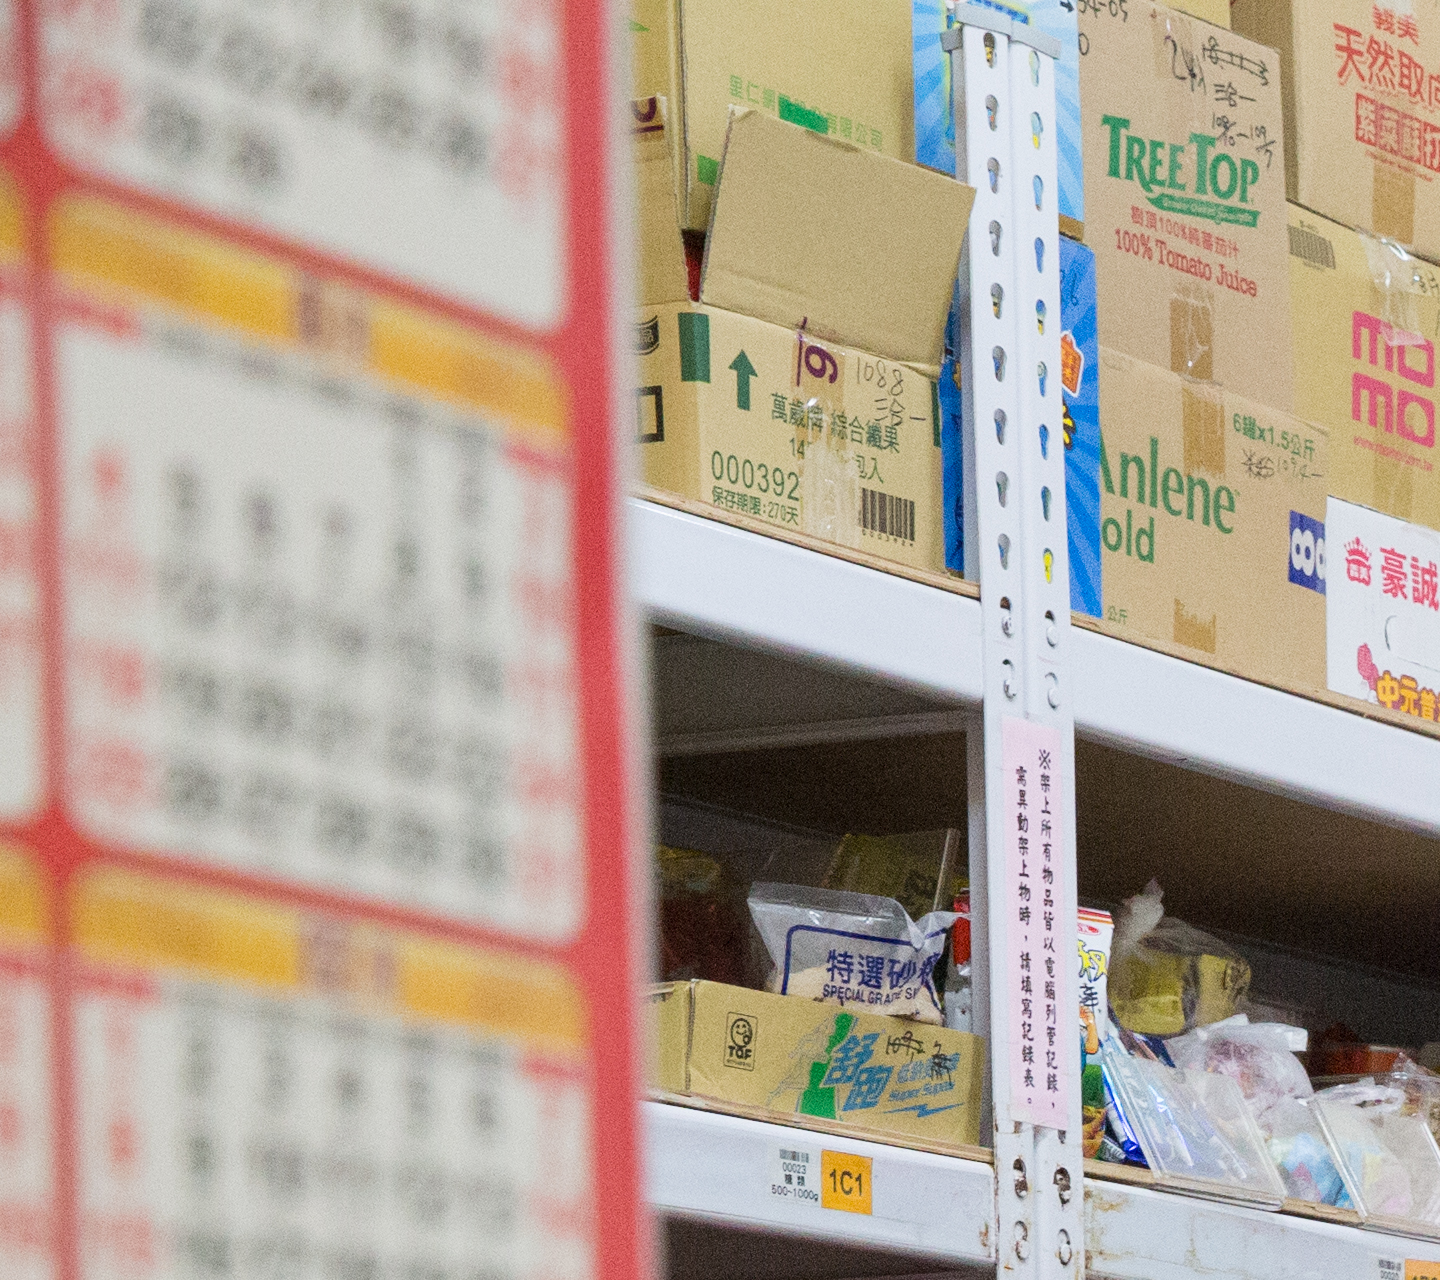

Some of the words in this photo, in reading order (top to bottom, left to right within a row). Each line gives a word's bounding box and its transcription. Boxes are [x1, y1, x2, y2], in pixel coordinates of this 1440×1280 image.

[1101, 113, 1187, 193] TREE
[1190, 132, 1260, 203] TOP
[1156, 238, 1212, 282] Tomato
[1216, 264, 1258, 298] Juice
[711, 450, 801, 502] 000392
[1102, 509, 1154, 564] old
[822, 1032, 894, 1112] 舒跑
[829, 1168, 864, 1197] 1C1
